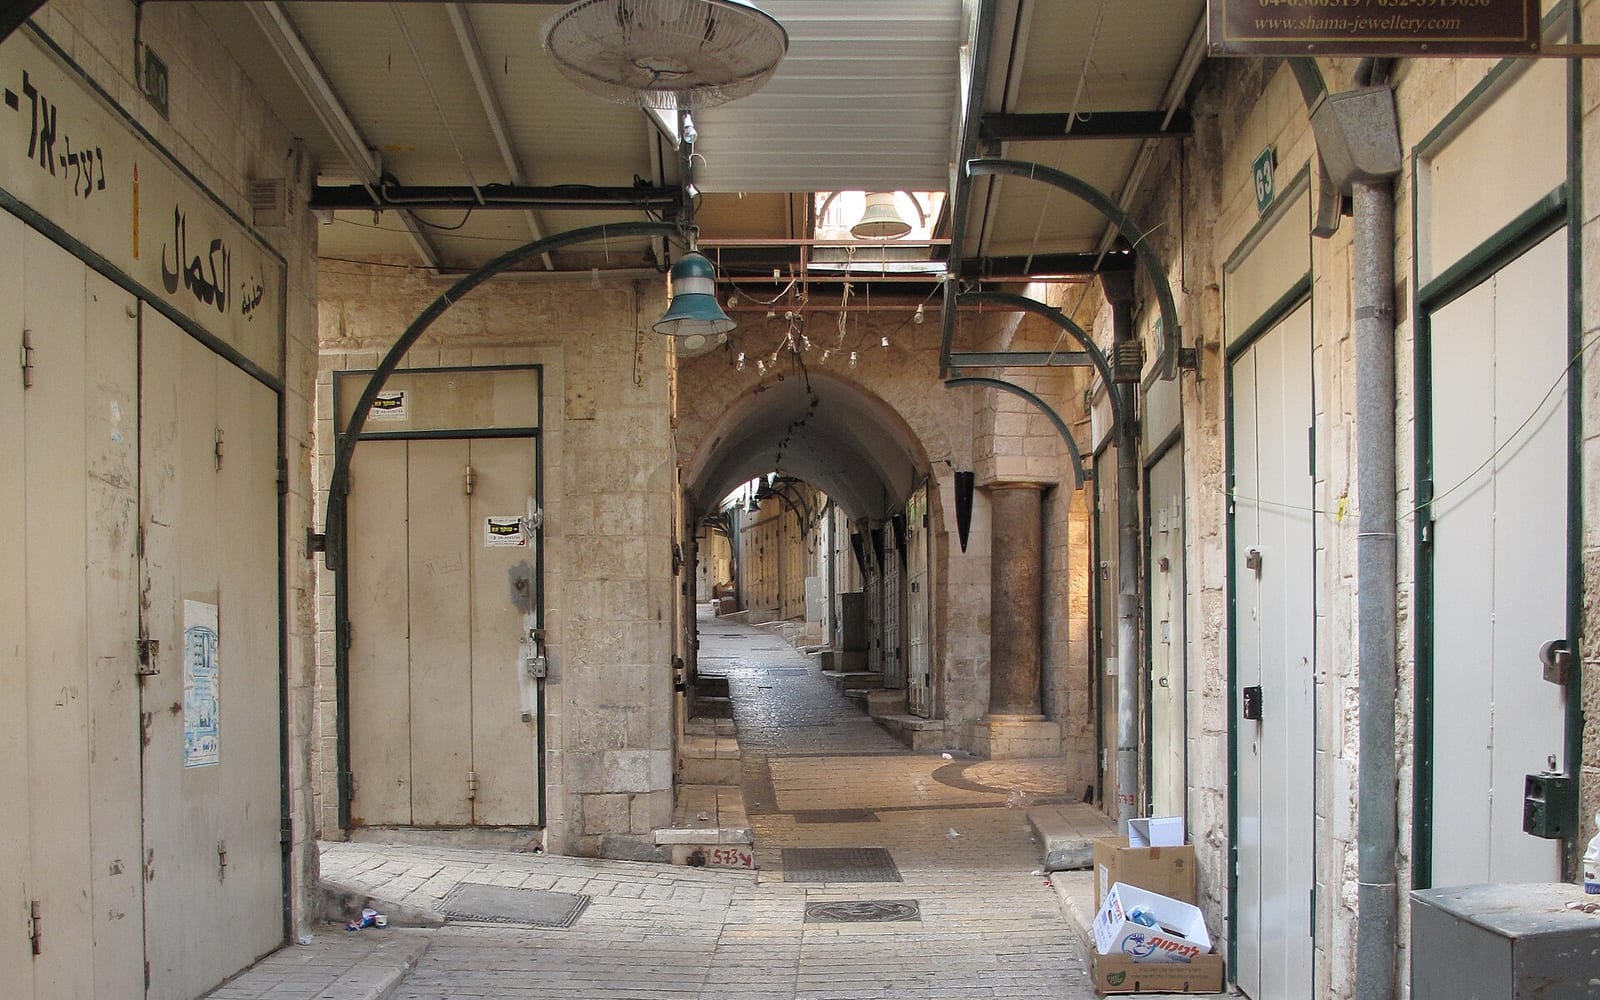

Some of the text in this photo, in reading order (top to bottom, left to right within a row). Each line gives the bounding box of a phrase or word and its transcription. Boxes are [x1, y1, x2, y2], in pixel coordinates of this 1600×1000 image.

[1255, 15, 1460, 33] www.shama-jewellery.com
[60, 135, 106, 201] נעלי
[1256, 160, 1272, 202] 63
[161, 202, 231, 316] الكمال
